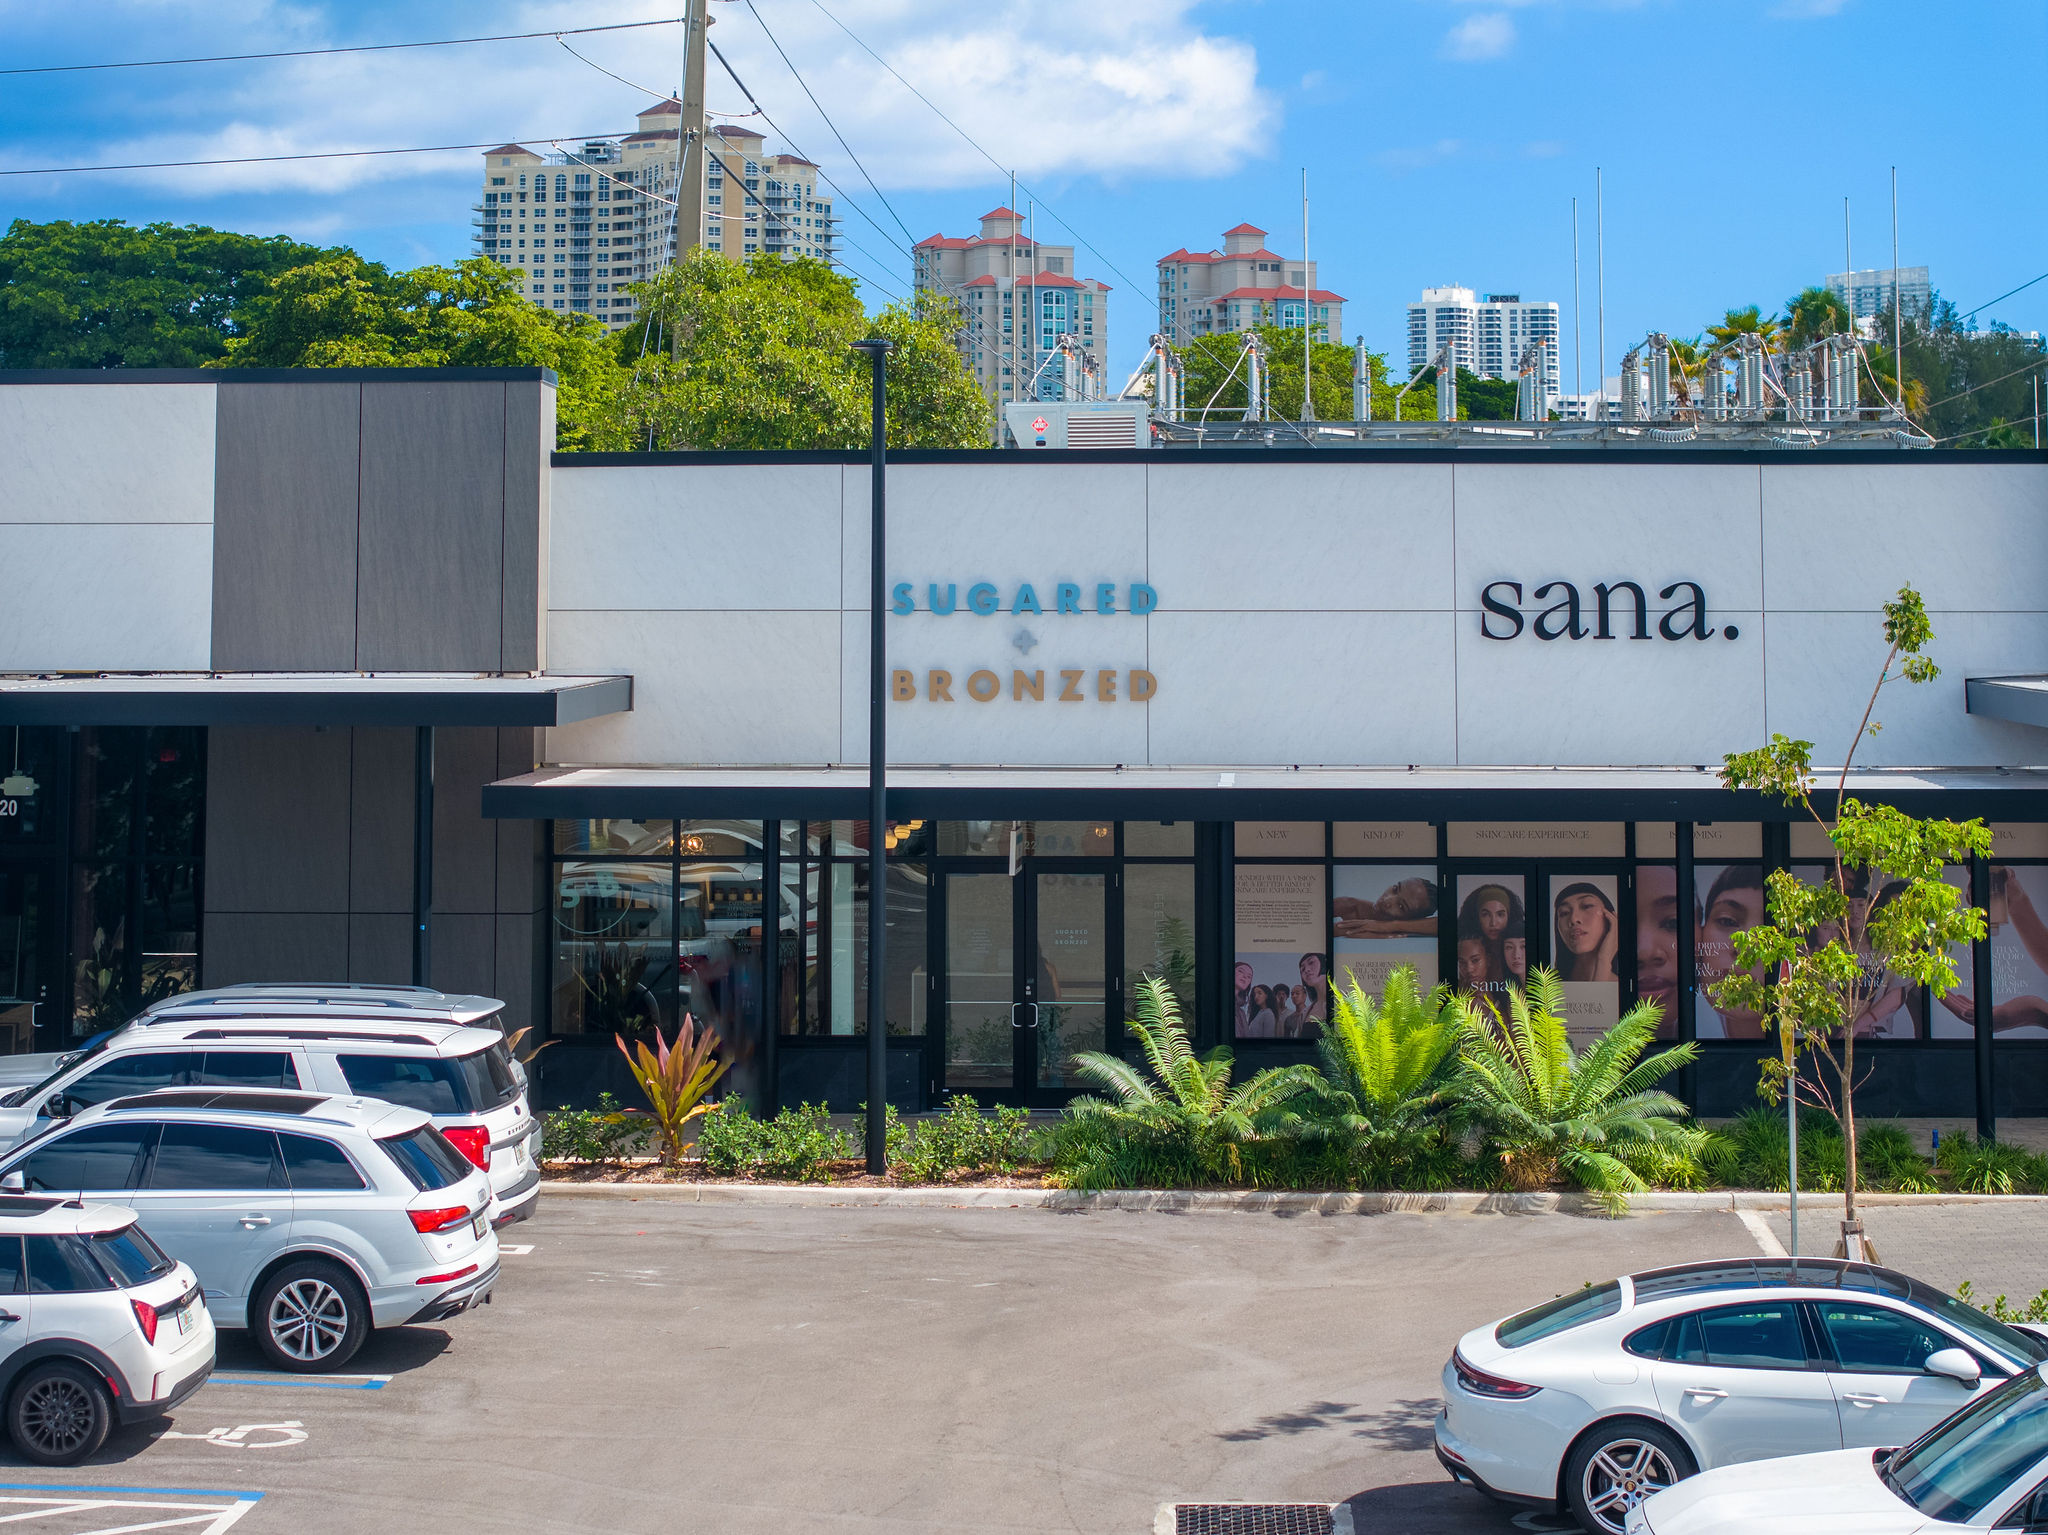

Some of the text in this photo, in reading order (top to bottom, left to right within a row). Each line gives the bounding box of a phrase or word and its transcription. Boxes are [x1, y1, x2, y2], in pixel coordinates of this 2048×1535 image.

[892, 583, 1158, 616] SUGARED
[1481, 581, 1739, 641] sana.
[892, 669, 1158, 702] BRONZED
[0, 799, 18, 817] 20
[1266, 831, 1289, 840] NEW
[1362, 831, 1405, 840] KIND OF
[1476, 830, 1590, 840] SKINCARE EXPERIENCE
